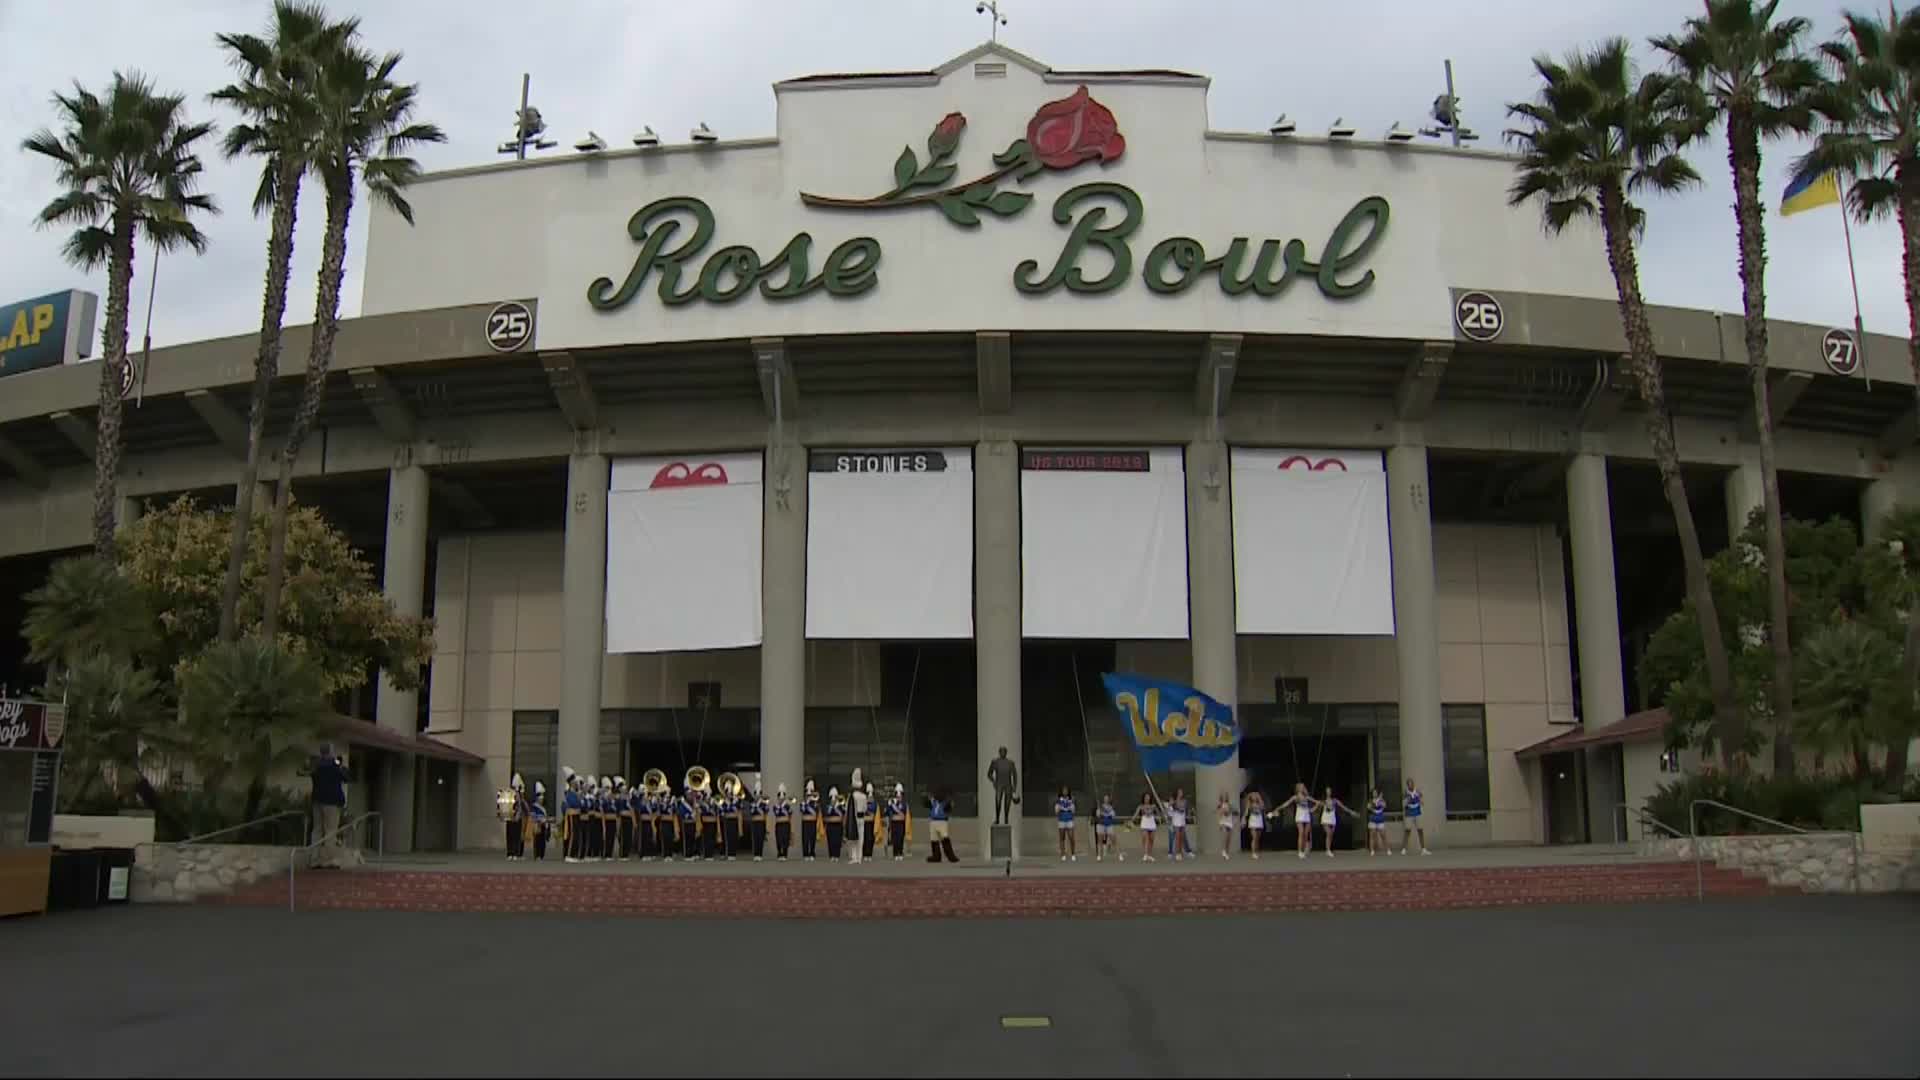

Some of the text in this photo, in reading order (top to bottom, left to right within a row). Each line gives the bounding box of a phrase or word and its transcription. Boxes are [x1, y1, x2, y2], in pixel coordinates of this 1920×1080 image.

[587, 181, 1390, 310] Rose Bowl
[490, 312, 528, 340] 25
[1460, 301, 1499, 329] 26
[1827, 338, 1853, 364] 27
[837, 455, 928, 472] STONES
[1055, 455, 1097, 469] TOUR
[1102, 455, 1143, 470] 2019
